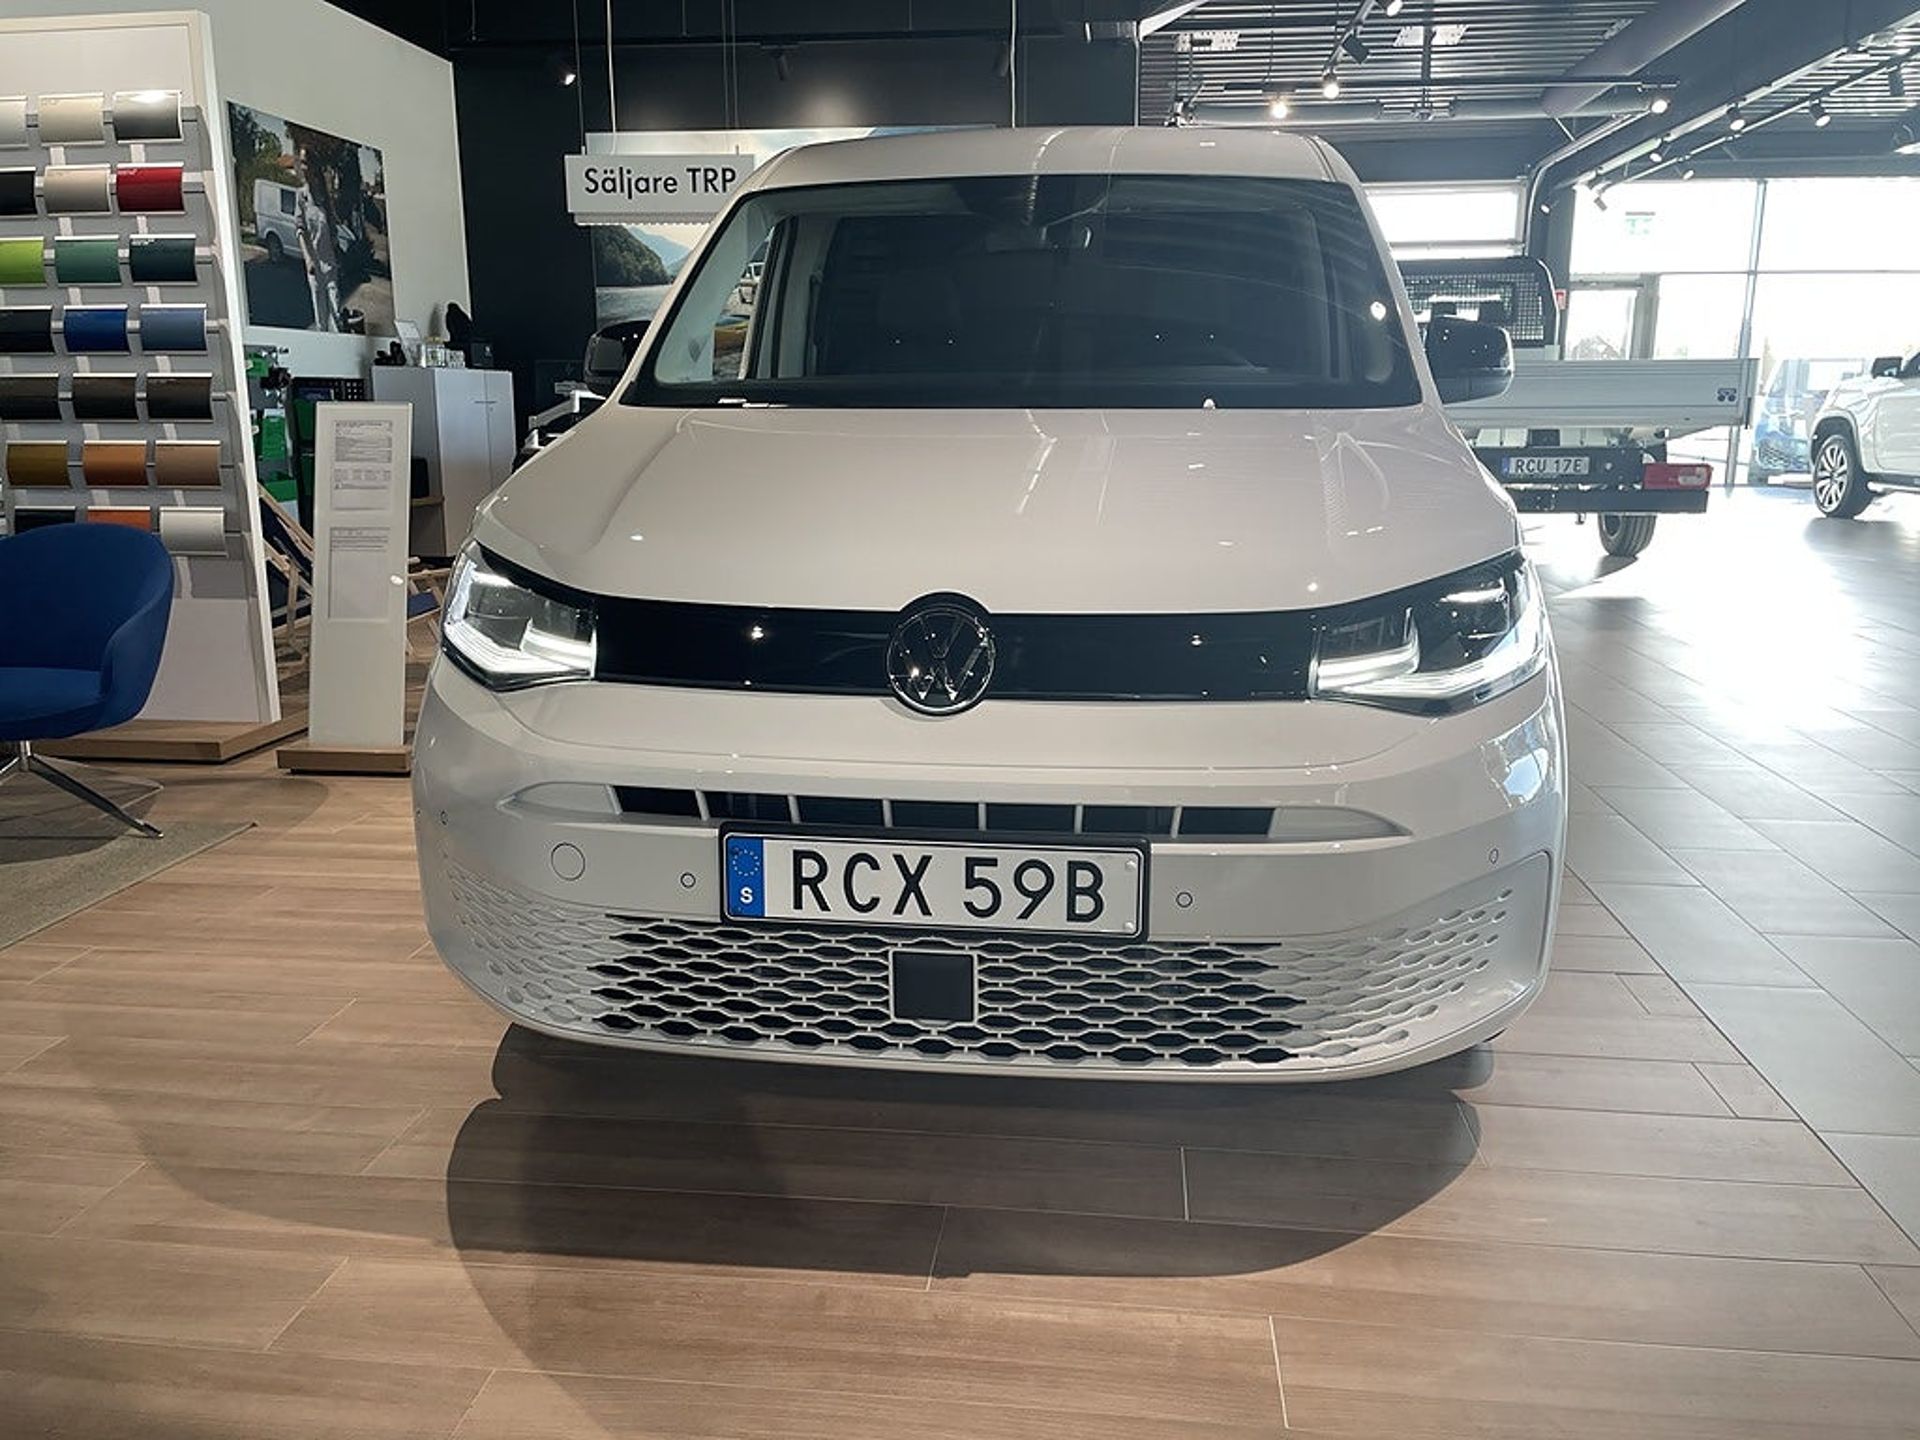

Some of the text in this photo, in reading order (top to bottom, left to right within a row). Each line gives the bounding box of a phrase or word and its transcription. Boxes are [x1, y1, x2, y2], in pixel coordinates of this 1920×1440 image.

[584, 166, 737, 200] Säljare TRP
[1515, 459, 1547, 473] RCU
[740, 887, 753, 904] S
[792, 849, 1106, 923] RCX 59B
